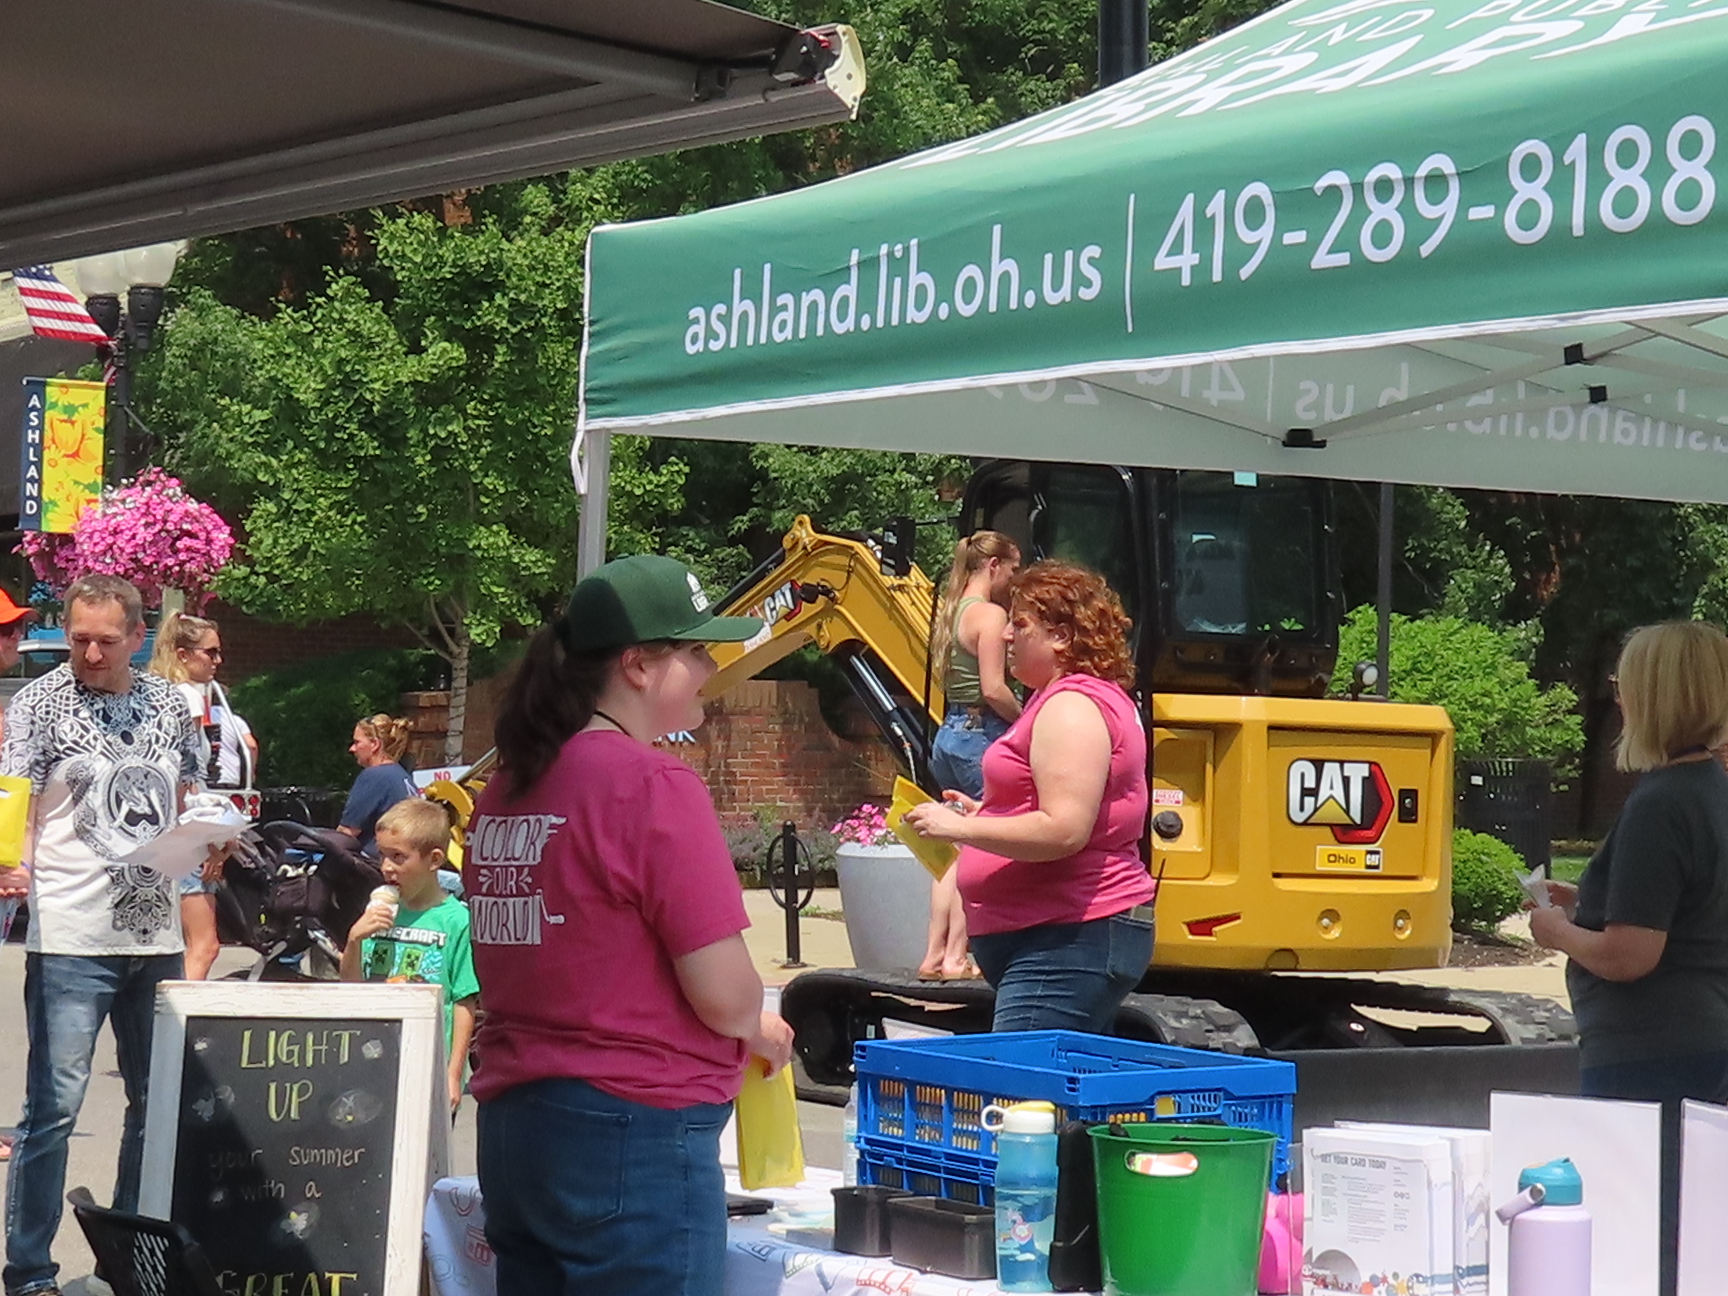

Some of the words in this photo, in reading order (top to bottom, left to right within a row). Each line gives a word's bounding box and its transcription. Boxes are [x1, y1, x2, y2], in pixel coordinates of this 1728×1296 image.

[683, 241, 1103, 356] ashland.lib.oh.us
[1154, 115, 1718, 290] 419-289-8188
[25, 393, 42, 515] ASHLAND
[1288, 759, 1370, 825] CAT
[480, 817, 543, 862] COLOR
[1327, 853, 1357, 865] Ohio
[473, 899, 531, 943] WORLD
[240, 1029, 361, 1069] LIGHT
[268, 1079, 314, 1122] UP
[210, 1147, 263, 1181] your
[288, 1145, 366, 1168] summer
[1334, 1155, 1349, 1166] YOUR
[1350, 1157, 1367, 1168] CARD
[1368, 1159, 1387, 1170] TODAY
[241, 1179, 285, 1201] with
[304, 1183, 322, 1199] a
